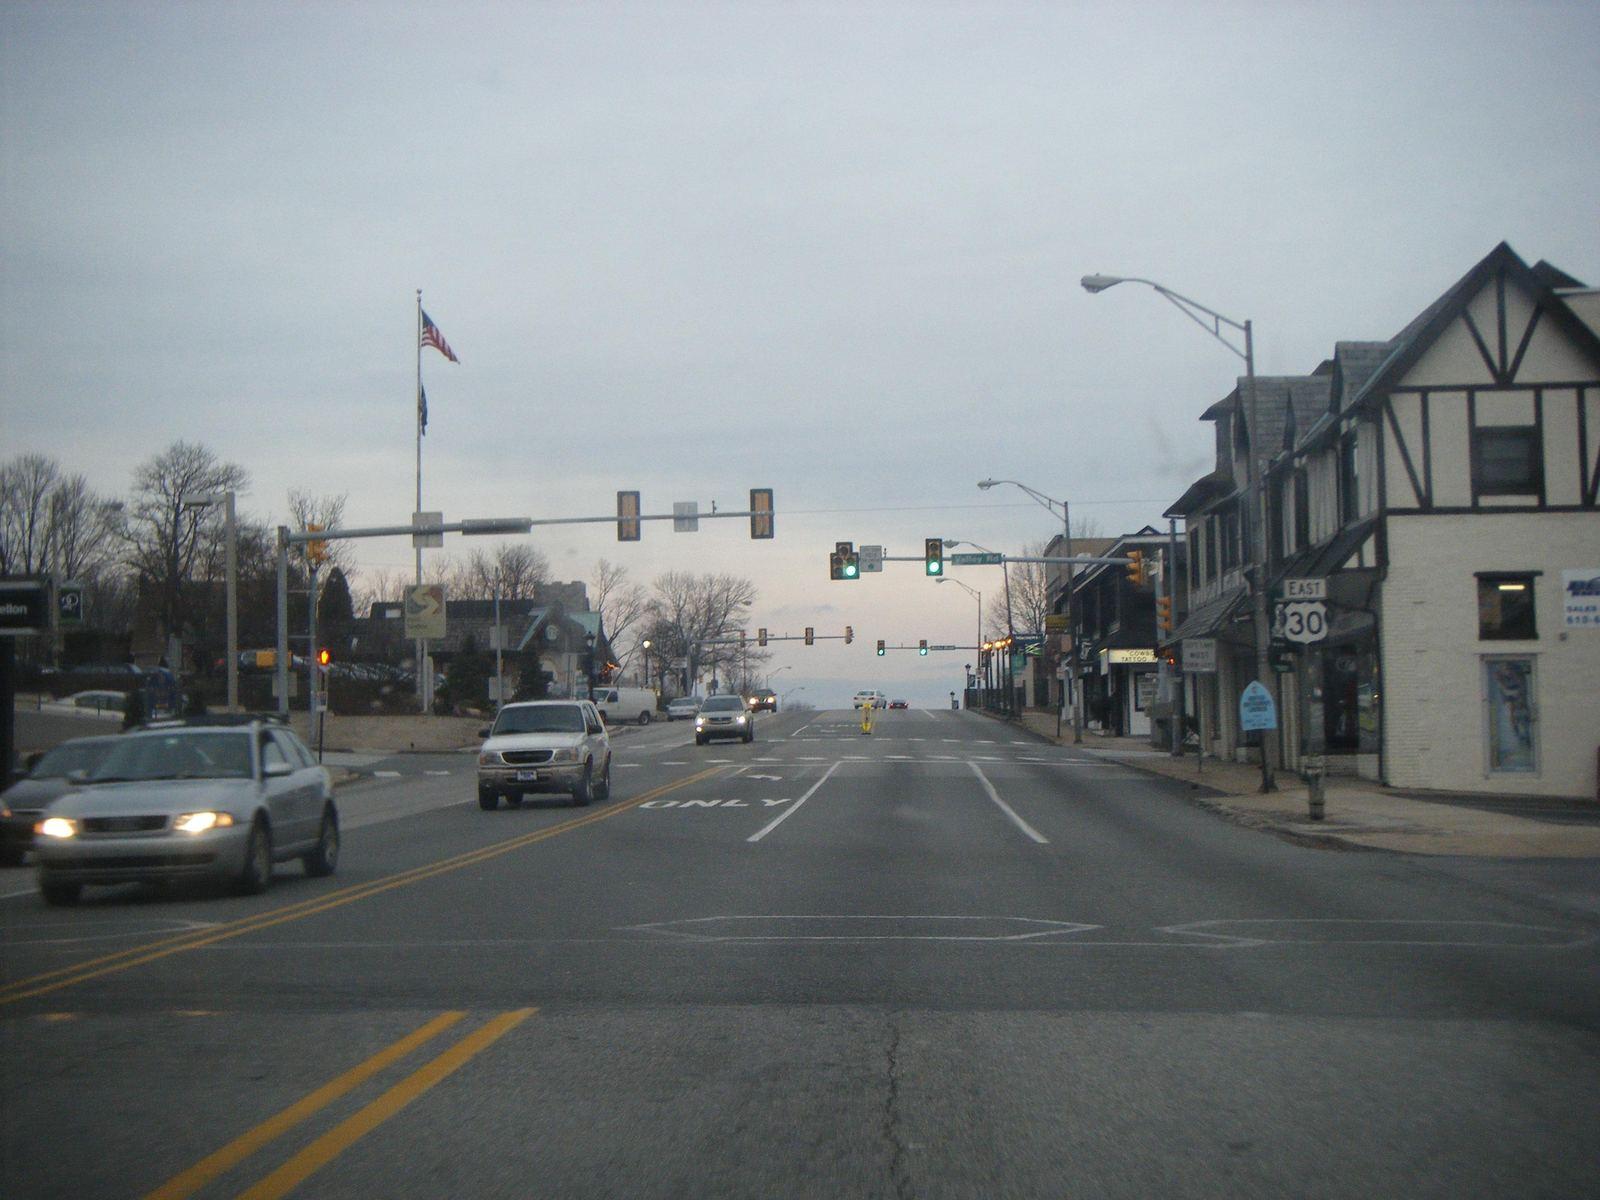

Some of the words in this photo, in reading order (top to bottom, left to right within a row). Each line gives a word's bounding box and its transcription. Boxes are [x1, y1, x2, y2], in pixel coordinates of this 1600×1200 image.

[954, 555, 983, 565] Valley
[986, 554, 1000, 563] Rd
[1288, 581, 1320, 595] EAST
[1289, 611, 1322, 635] 30
[639, 799, 791, 809] ONLY
